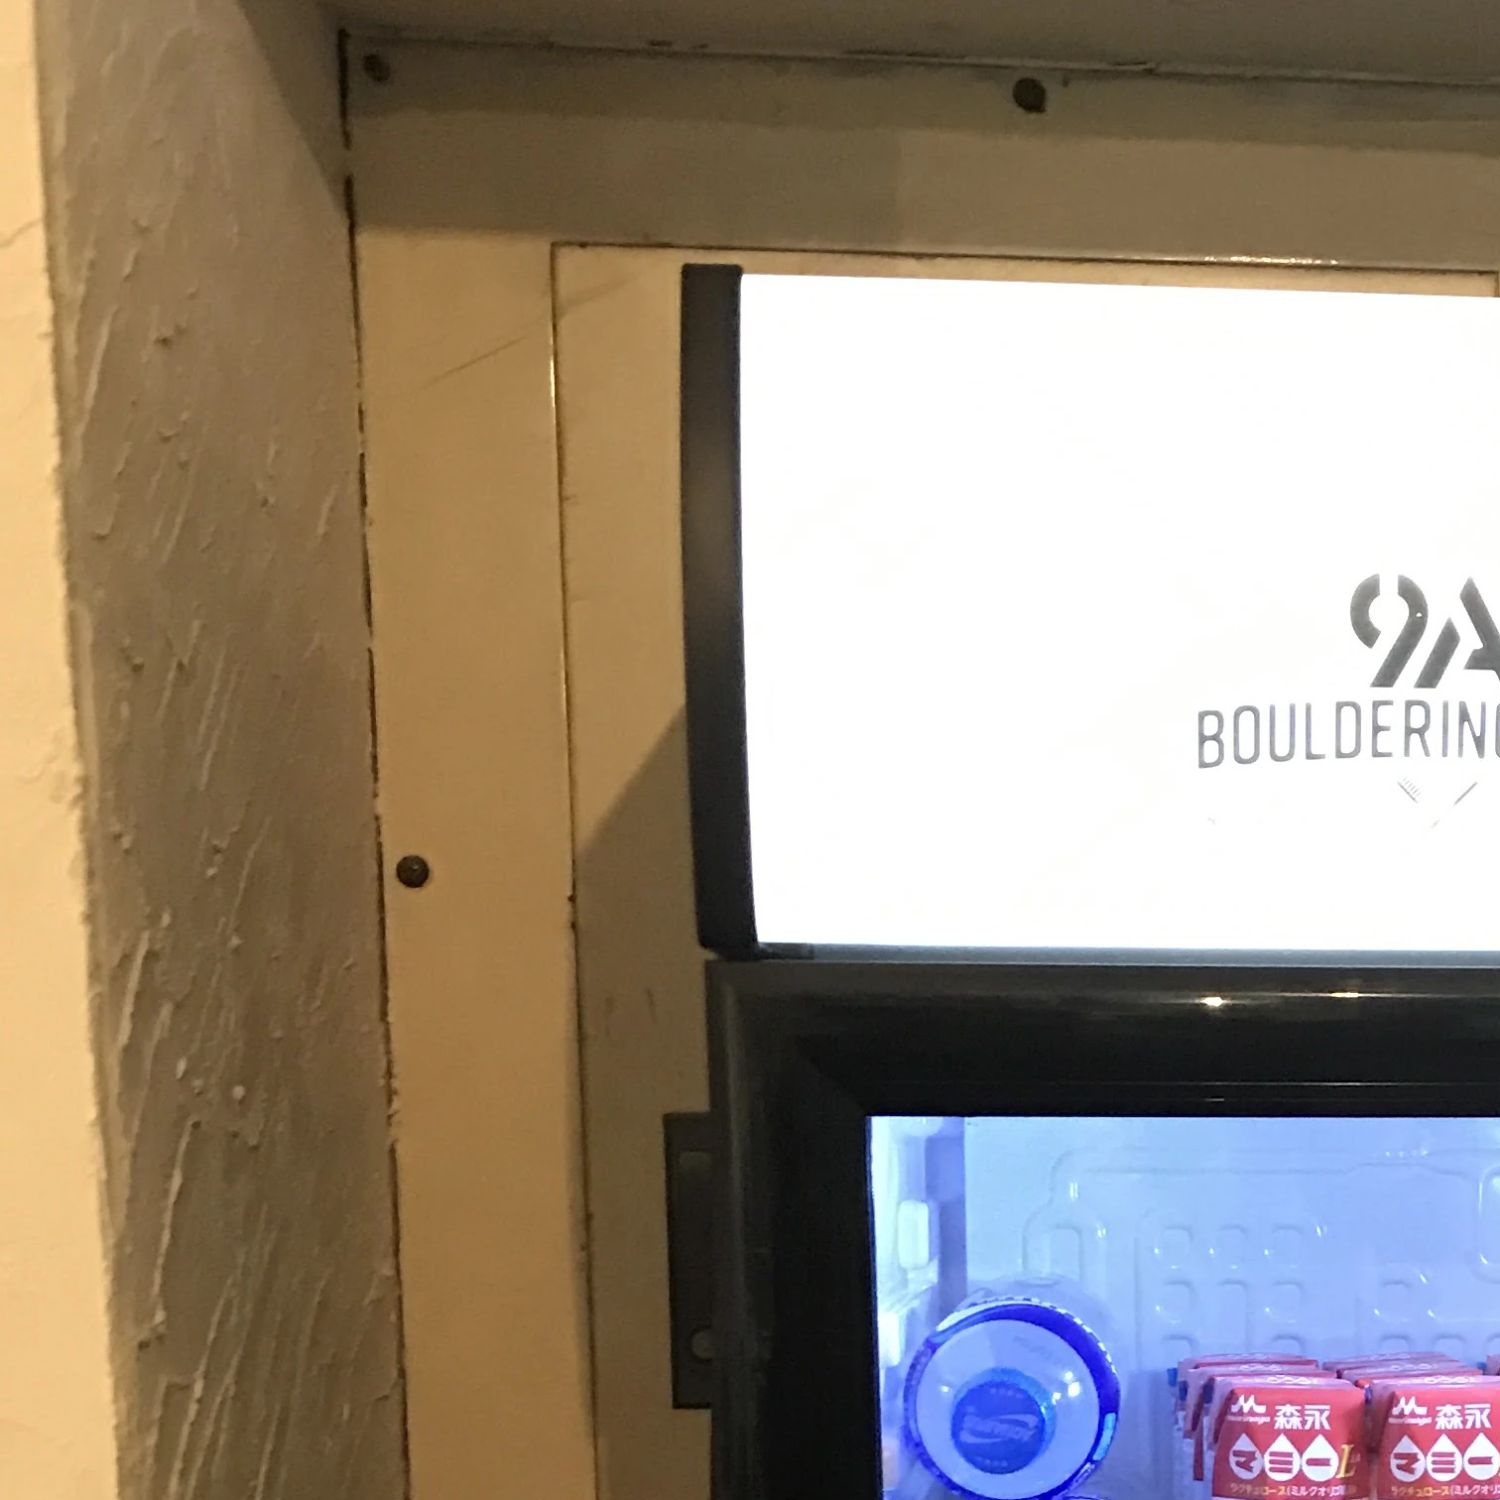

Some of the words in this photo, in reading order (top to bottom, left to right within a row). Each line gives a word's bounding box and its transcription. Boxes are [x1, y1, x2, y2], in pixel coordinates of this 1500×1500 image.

[1273, 1403, 1331, 1430] 森永
[1435, 1403, 1492, 1430] 森永
[1230, 1447, 1333, 1476] マミー
[1391, 1448, 1495, 1477] マミー
